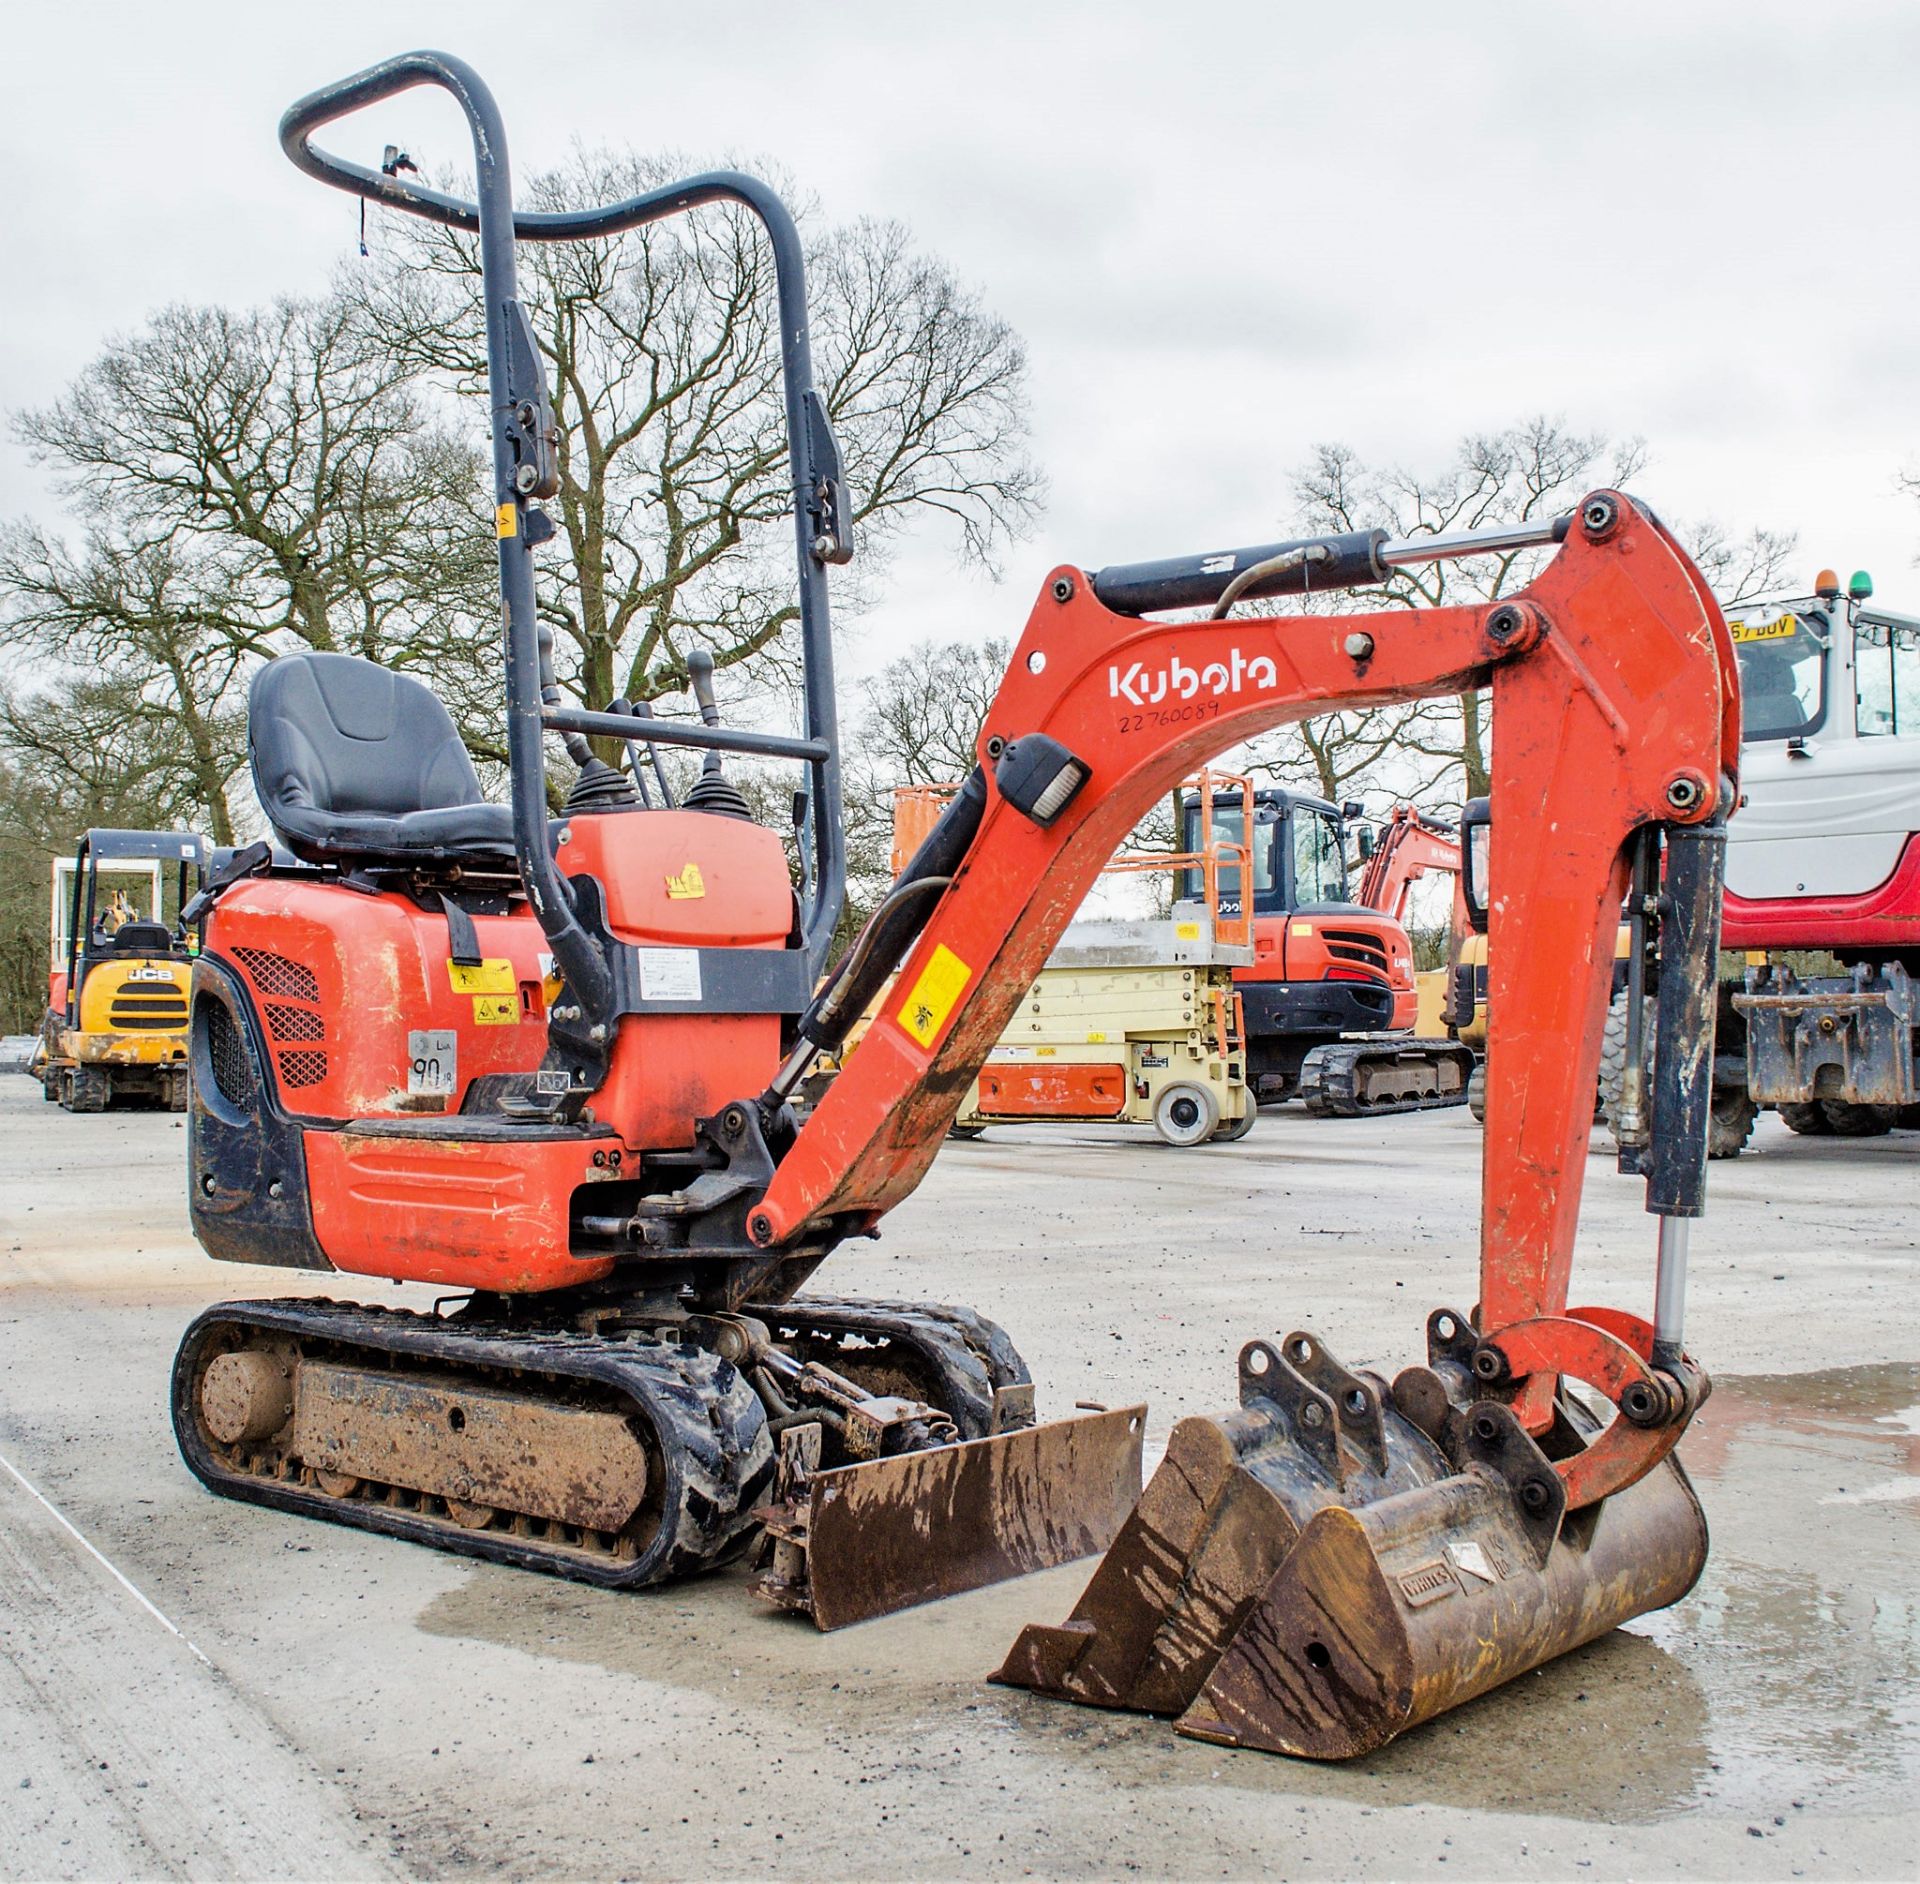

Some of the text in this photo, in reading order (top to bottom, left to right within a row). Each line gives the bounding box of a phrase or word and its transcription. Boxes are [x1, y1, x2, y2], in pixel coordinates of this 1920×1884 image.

[1109, 648, 1277, 706] Kubota
[1119, 702, 1219, 734] 22760089
[127, 969, 174, 981] JCB
